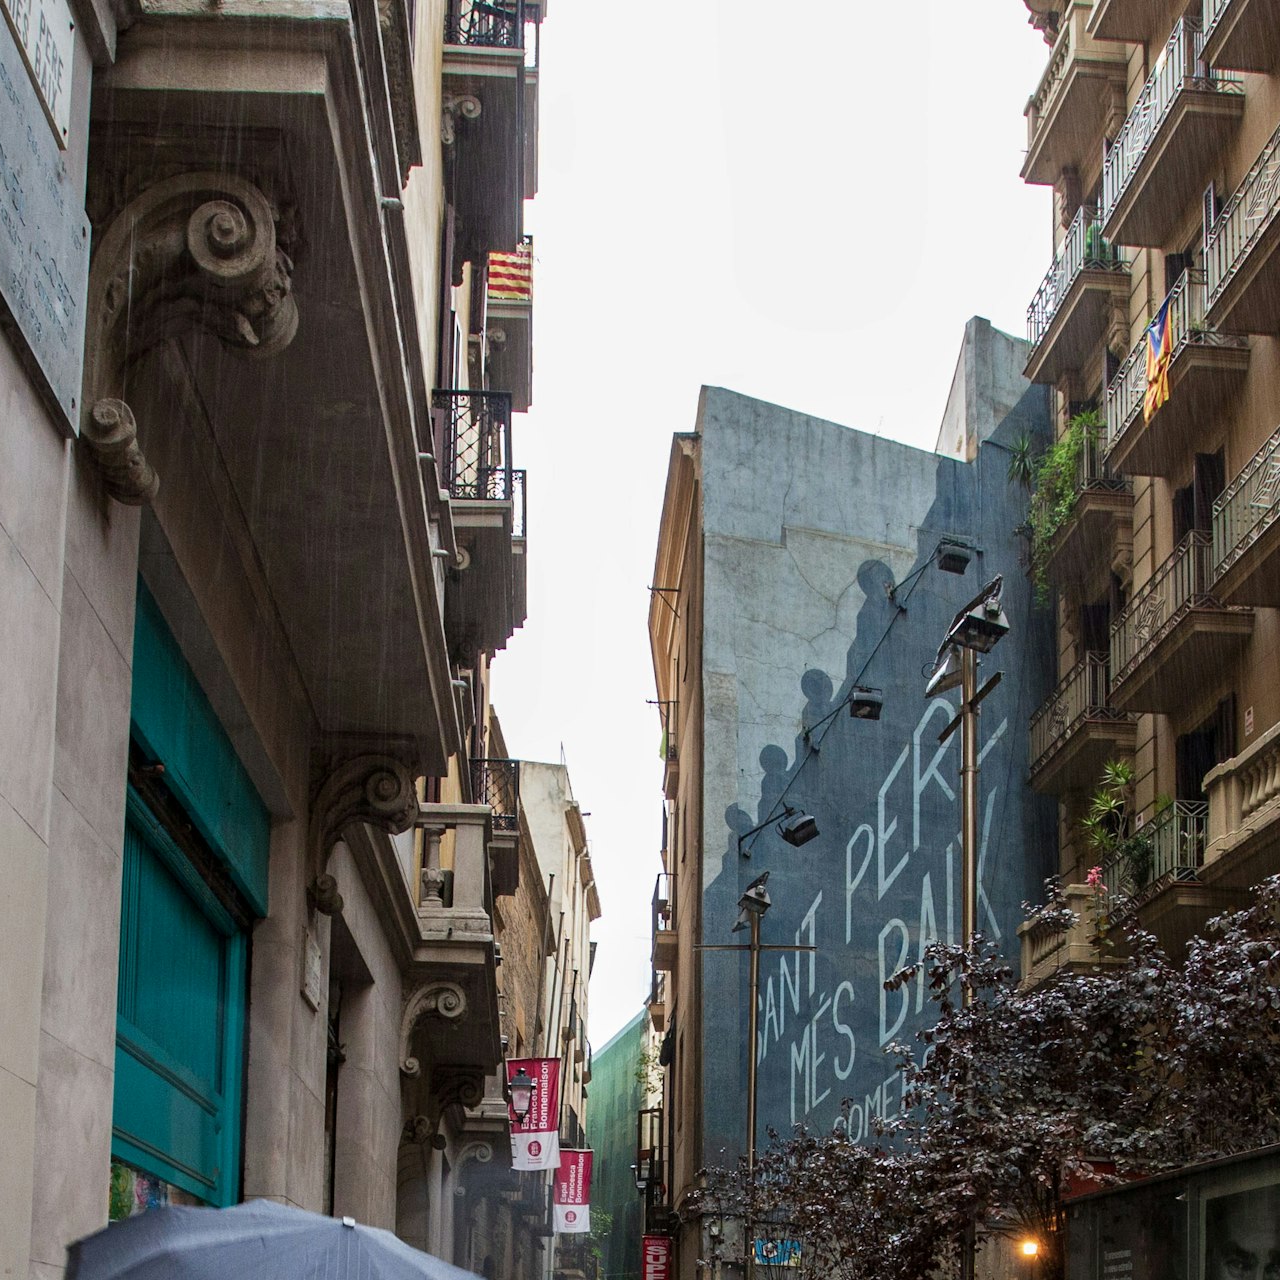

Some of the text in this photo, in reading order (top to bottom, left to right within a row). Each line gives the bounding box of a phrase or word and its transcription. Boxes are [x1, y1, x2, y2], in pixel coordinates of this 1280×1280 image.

[538, 1060, 549, 1129] Bonnemaison
[560, 1182, 568, 1203] Espai
[568, 1164, 576, 1203] Francesca
[575, 1153, 585, 1203] Bonnemaison
